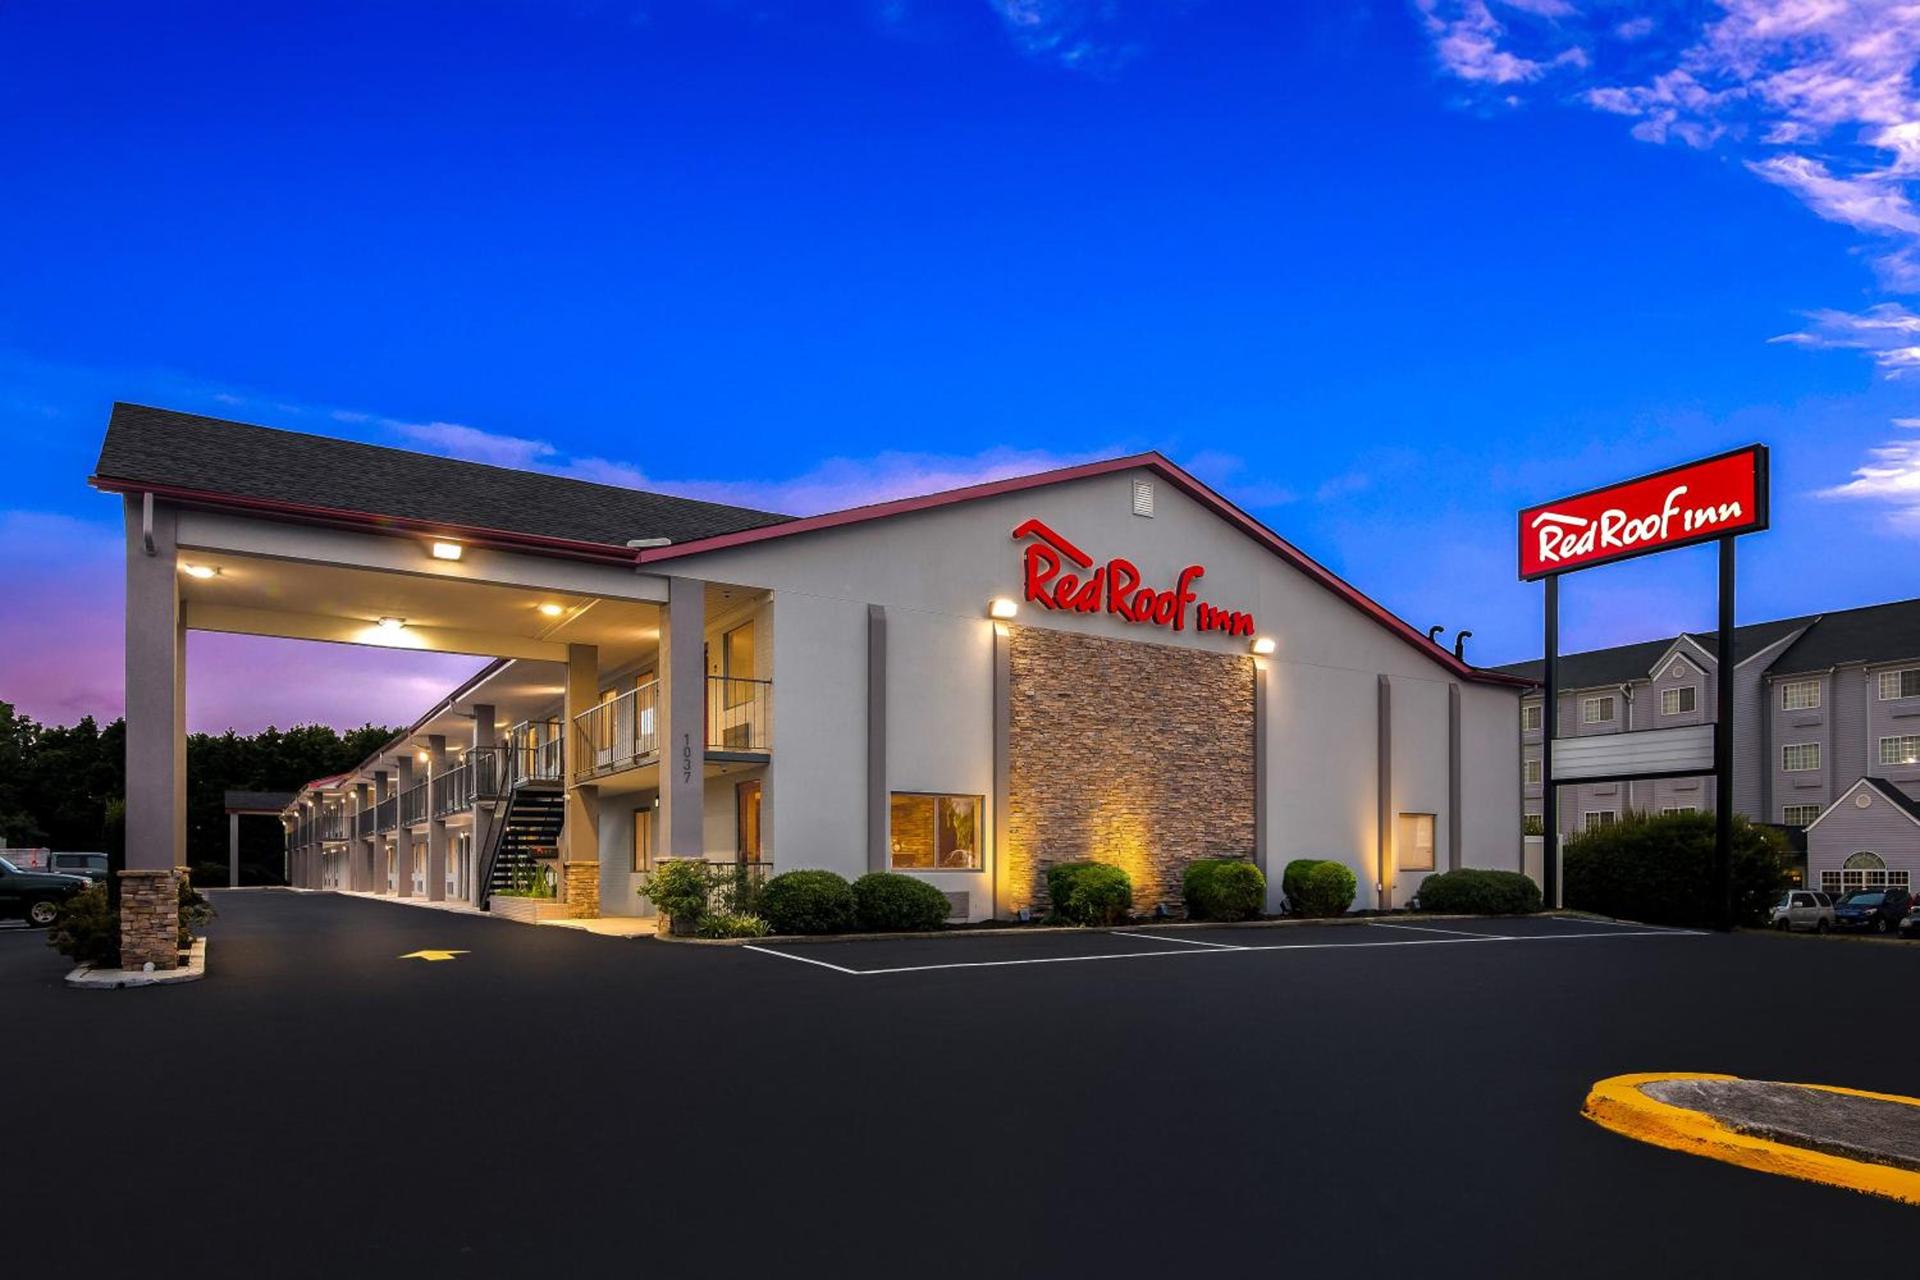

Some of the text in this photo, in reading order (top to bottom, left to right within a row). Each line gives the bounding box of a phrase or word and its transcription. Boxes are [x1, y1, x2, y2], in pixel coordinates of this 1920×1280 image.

[1539, 521, 1597, 562] Red
[1600, 485, 1687, 548] Roof
[1024, 543, 1105, 613] Red
[1106, 559, 1205, 631] Roof
[683, 733, 692, 784] 1037
